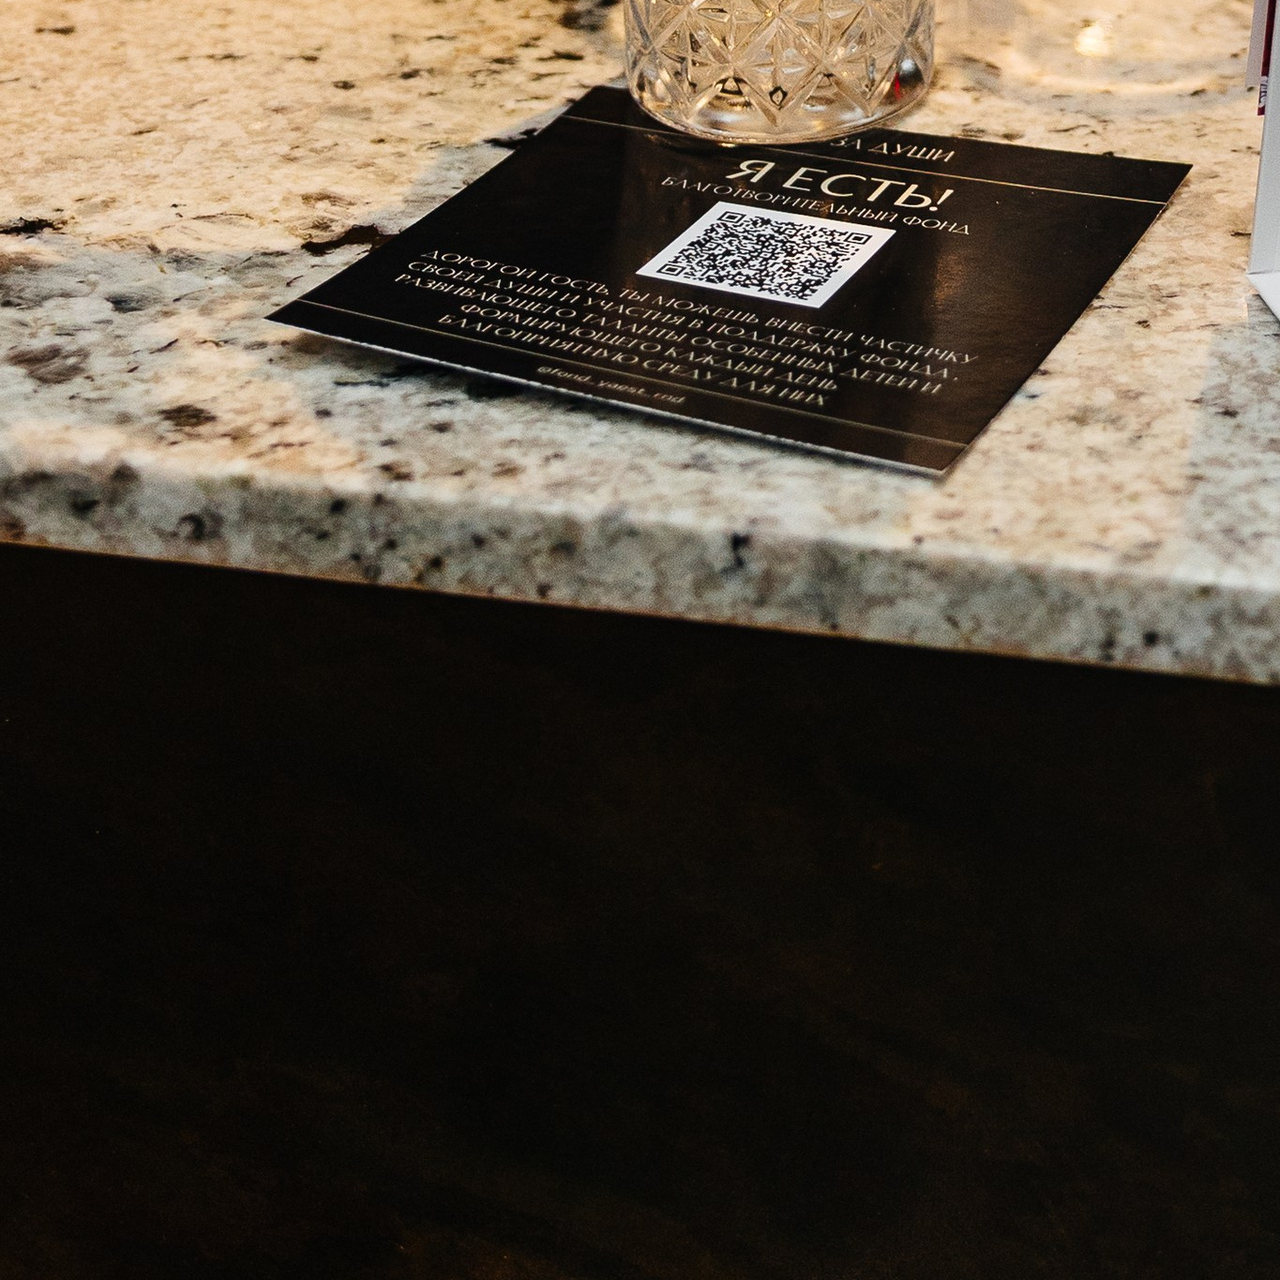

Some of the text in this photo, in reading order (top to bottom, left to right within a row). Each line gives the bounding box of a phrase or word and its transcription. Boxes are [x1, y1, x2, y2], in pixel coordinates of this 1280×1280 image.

[725, 158, 954, 212] Я ЕСТЬ!
[868, 142, 955, 162] ДУШИ
[661, 176, 970, 236] БЛАГОТВОРИТЕЛЬНЫЙ ФОНД
[394, 272, 944, 396] РАЗВИВАЮЩЕГО ТАЛАНТЫ ОСОБЕННЫХ ДЕТЕЙ И
[407, 260, 485, 284] СВОЕЙ
[484, 277, 558, 300] ДУШИ
[560, 292, 581, 304] И
[583, 296, 687, 326] УЧАСТИЯ
[688, 318, 701, 330] В
[706, 321, 857, 358] ПОДДЕРЖКУ
[421, 249, 537, 280] ДОРОГОЙ
[619, 287, 651, 302] ТЫ
[651, 295, 760, 325] МОЖЕШЬ
[765, 316, 853, 343] ВНЕСТИ
[860, 334, 979, 365] ЧАСТИЧКУ
[460, 302, 839, 391] ФОРМИРУЮЩЕГО КАЖДЫЙ ДЕНЬ
[438, 313, 831, 407] БЛАГОПРИЯТНУЮ СРЕДУ ДЛЯ НИХ
